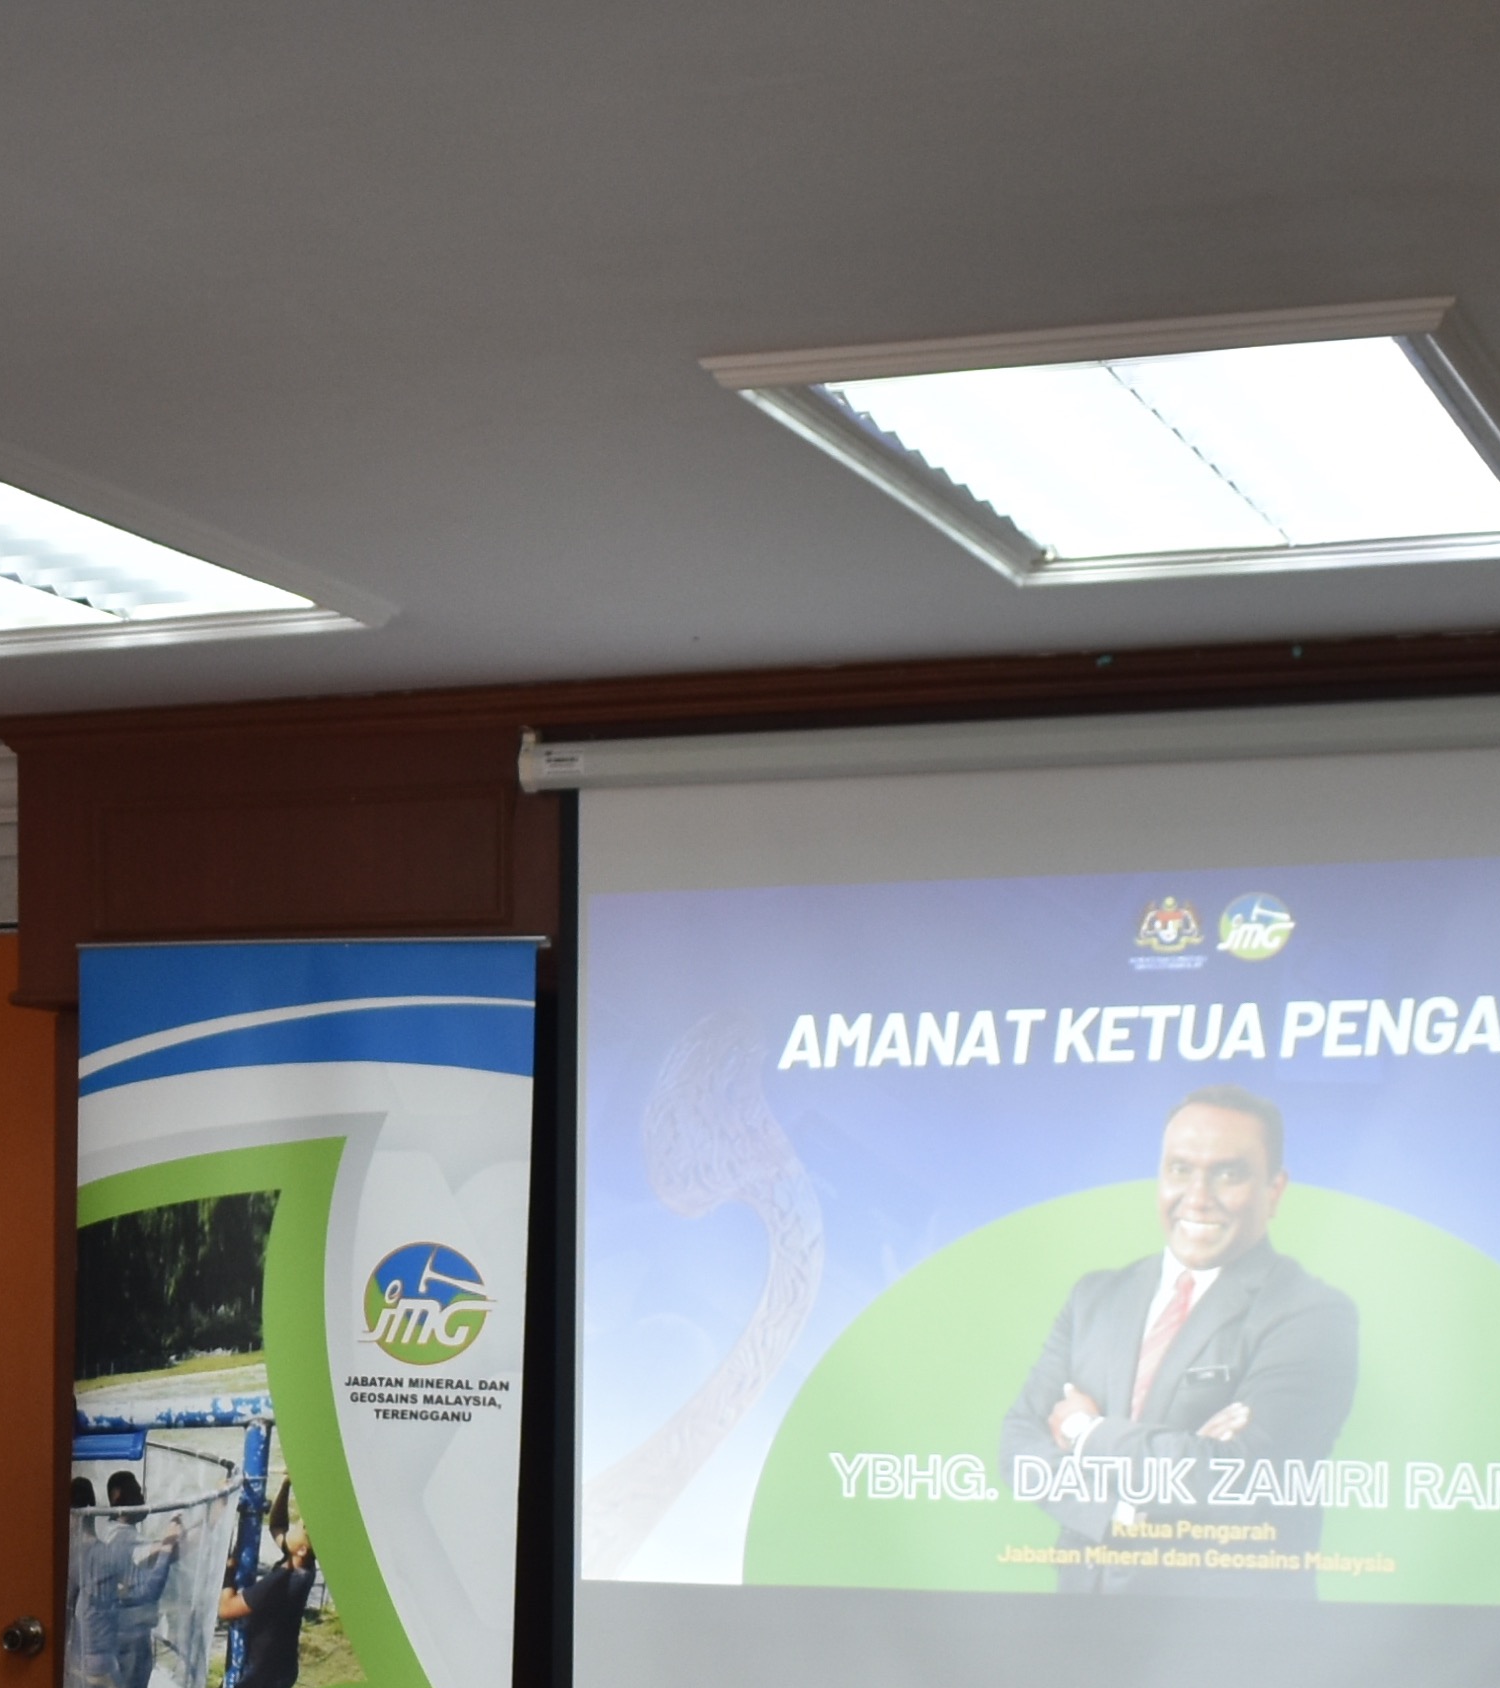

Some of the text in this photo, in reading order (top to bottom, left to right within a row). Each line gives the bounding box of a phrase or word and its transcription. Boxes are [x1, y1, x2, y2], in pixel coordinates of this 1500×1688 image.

[777, 1009, 1047, 1070] AMANAT
[1053, 1002, 1266, 1064] KETUA
[344, 1376, 510, 1392] JABATAN MINERAL DAN
[349, 1391, 502, 1410] GEOSAINS MALAYSIA,
[373, 1408, 472, 1422] TERENGGANU
[828, 1452, 999, 1501] YBHG.
[1013, 1454, 1197, 1505] DATUK
[1207, 1458, 1390, 1509] ZAMRI
[1112, 1520, 1276, 1545] Ketua Pengarah
[997, 1545, 1396, 1577] Jabatan Mineral dan Geosains Malaysia
